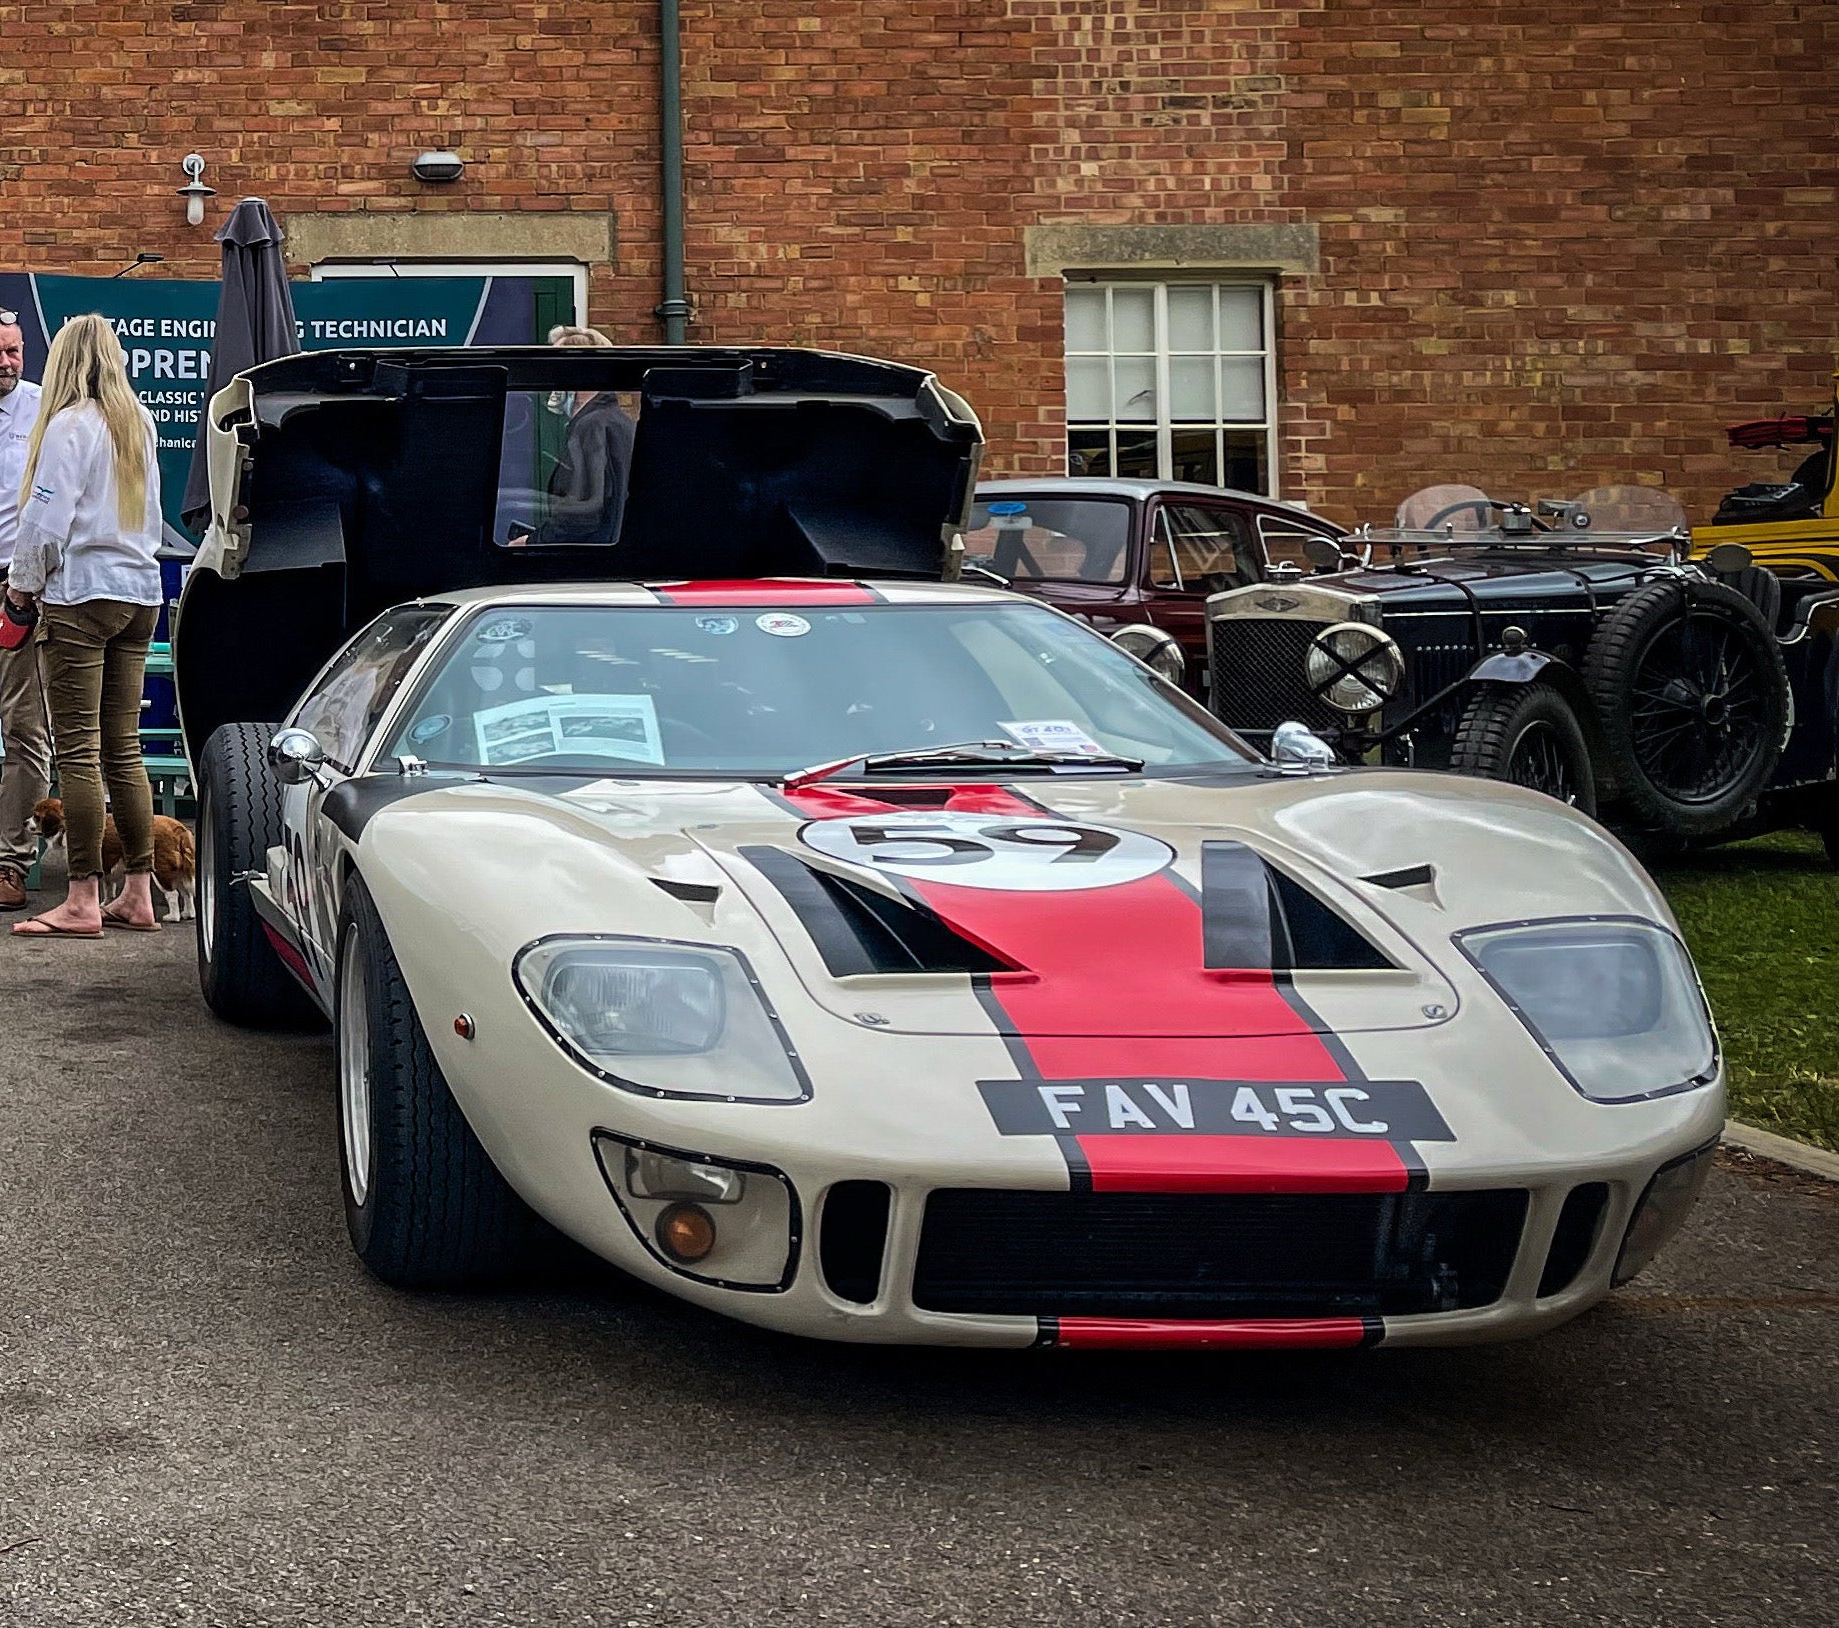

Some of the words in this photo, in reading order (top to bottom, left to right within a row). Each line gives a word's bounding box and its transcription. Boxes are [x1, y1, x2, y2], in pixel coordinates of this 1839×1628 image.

[310, 318, 447, 338] TECHNICIAN
[138, 391, 197, 405] CLASSIC
[151, 409, 171, 422] ND
[174, 410, 202, 423] HIS
[848, 824, 1122, 866] 59
[1037, 1083, 1195, 1129] FAV
[1230, 1086, 1389, 1134] 45C
